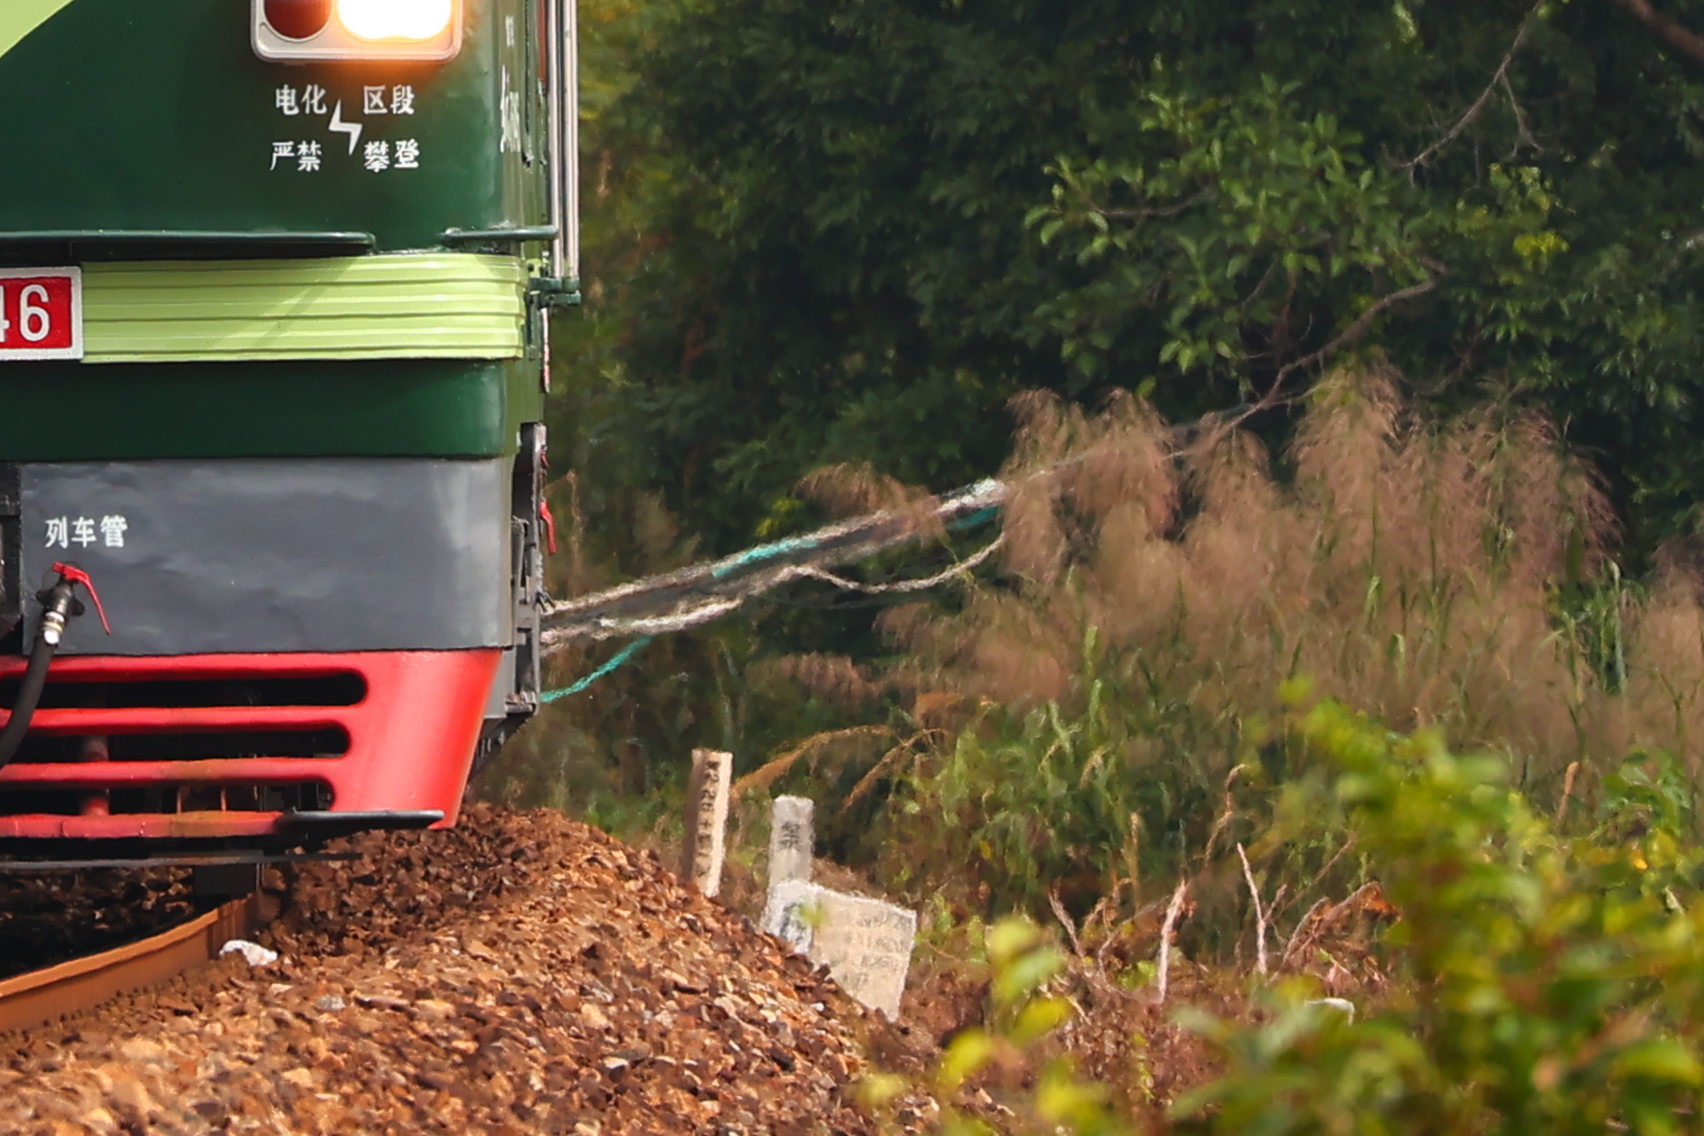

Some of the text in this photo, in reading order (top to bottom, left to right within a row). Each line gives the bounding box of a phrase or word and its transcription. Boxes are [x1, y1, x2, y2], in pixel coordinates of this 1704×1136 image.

[275, 84, 415, 116] 电化 区段
[269, 138, 421, 173] 严禁 攀登
[44, 514, 128, 549] 列车管
